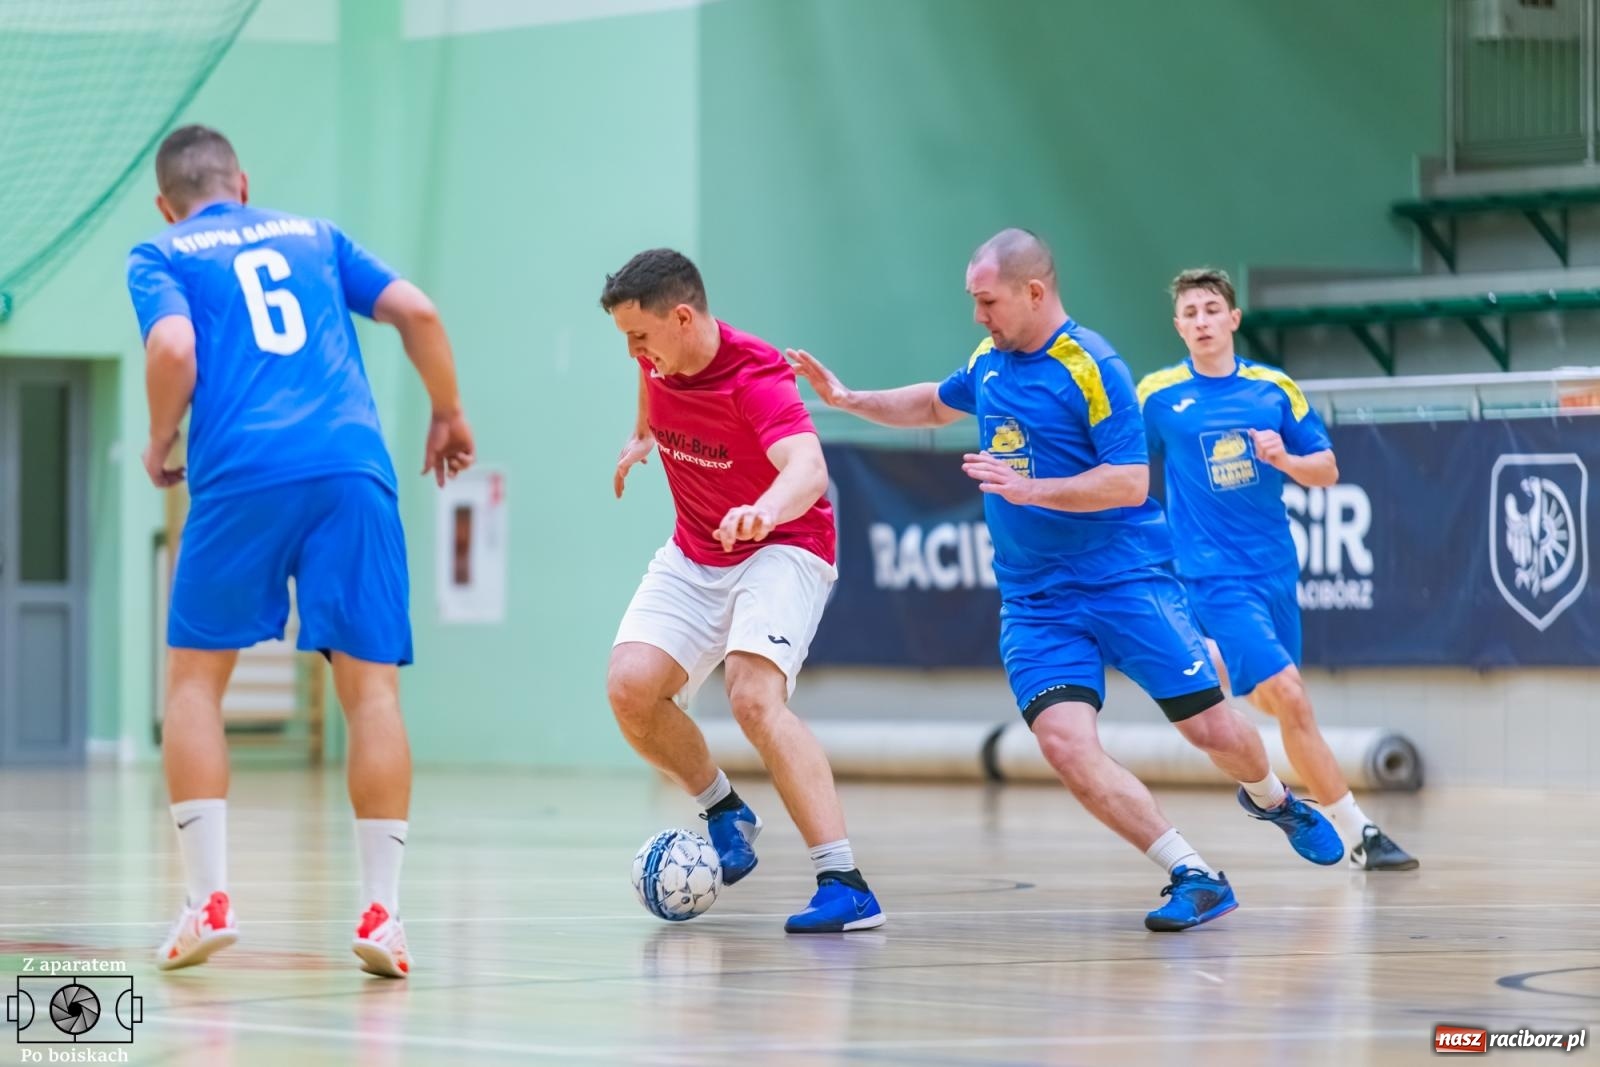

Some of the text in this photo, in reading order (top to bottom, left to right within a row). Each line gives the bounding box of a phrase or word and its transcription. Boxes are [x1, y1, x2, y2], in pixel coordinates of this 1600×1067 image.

[234, 247, 307, 356] 6
[867, 521, 998, 590] RACIB
[1281, 482, 1374, 576] SiR
